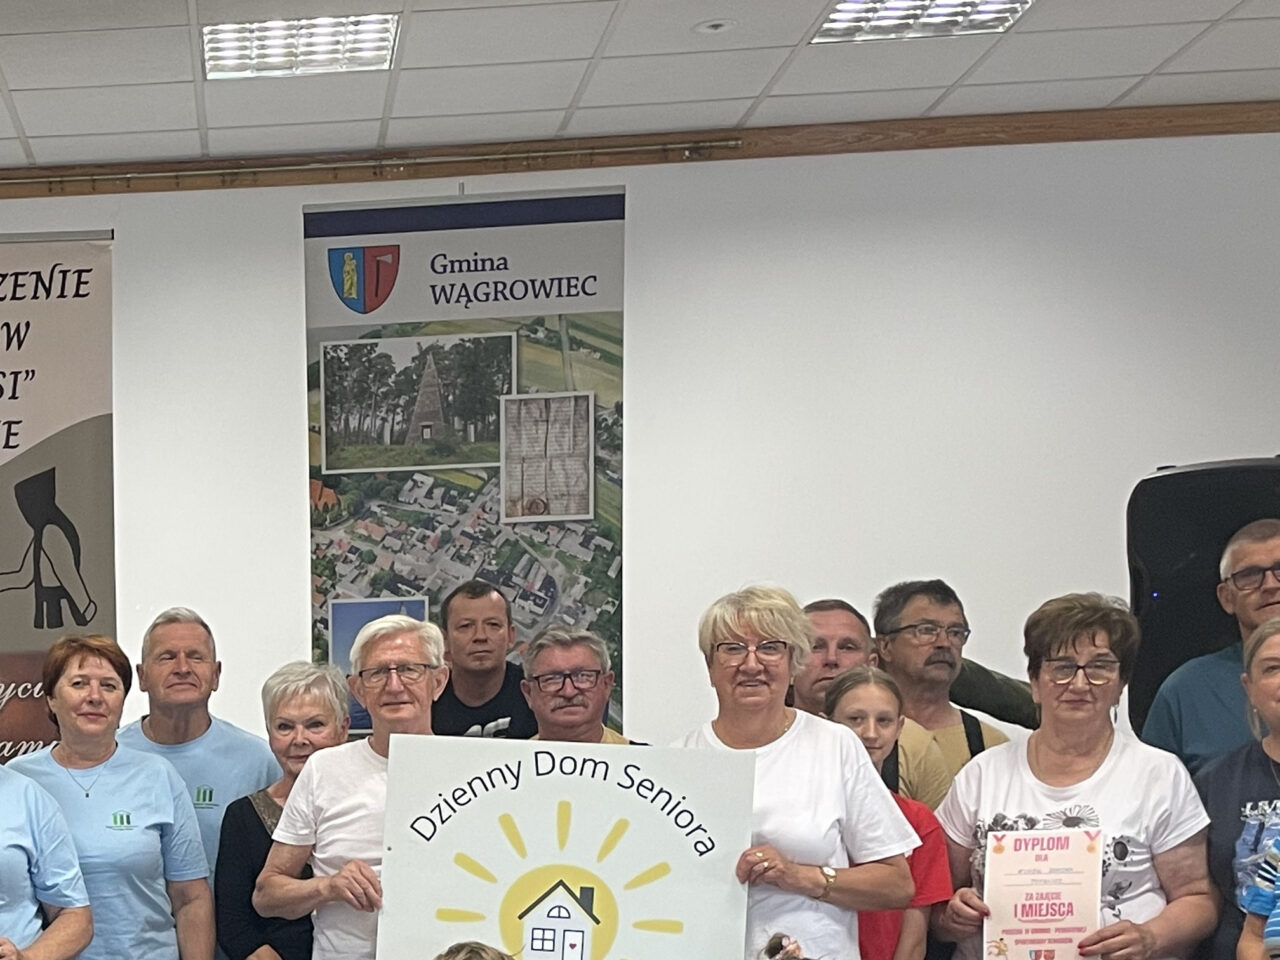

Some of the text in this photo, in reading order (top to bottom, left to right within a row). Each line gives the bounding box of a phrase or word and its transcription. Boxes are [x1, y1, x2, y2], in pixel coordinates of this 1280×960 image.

[430, 252, 509, 275] Gmina
[430, 275, 597, 309] WĄGROWIEC
[409, 750, 716, 857] Dzienny Dom Seniora
[1014, 836, 1069, 852] DYPLOM
[1021, 902, 1074, 918] MIEJSCA
